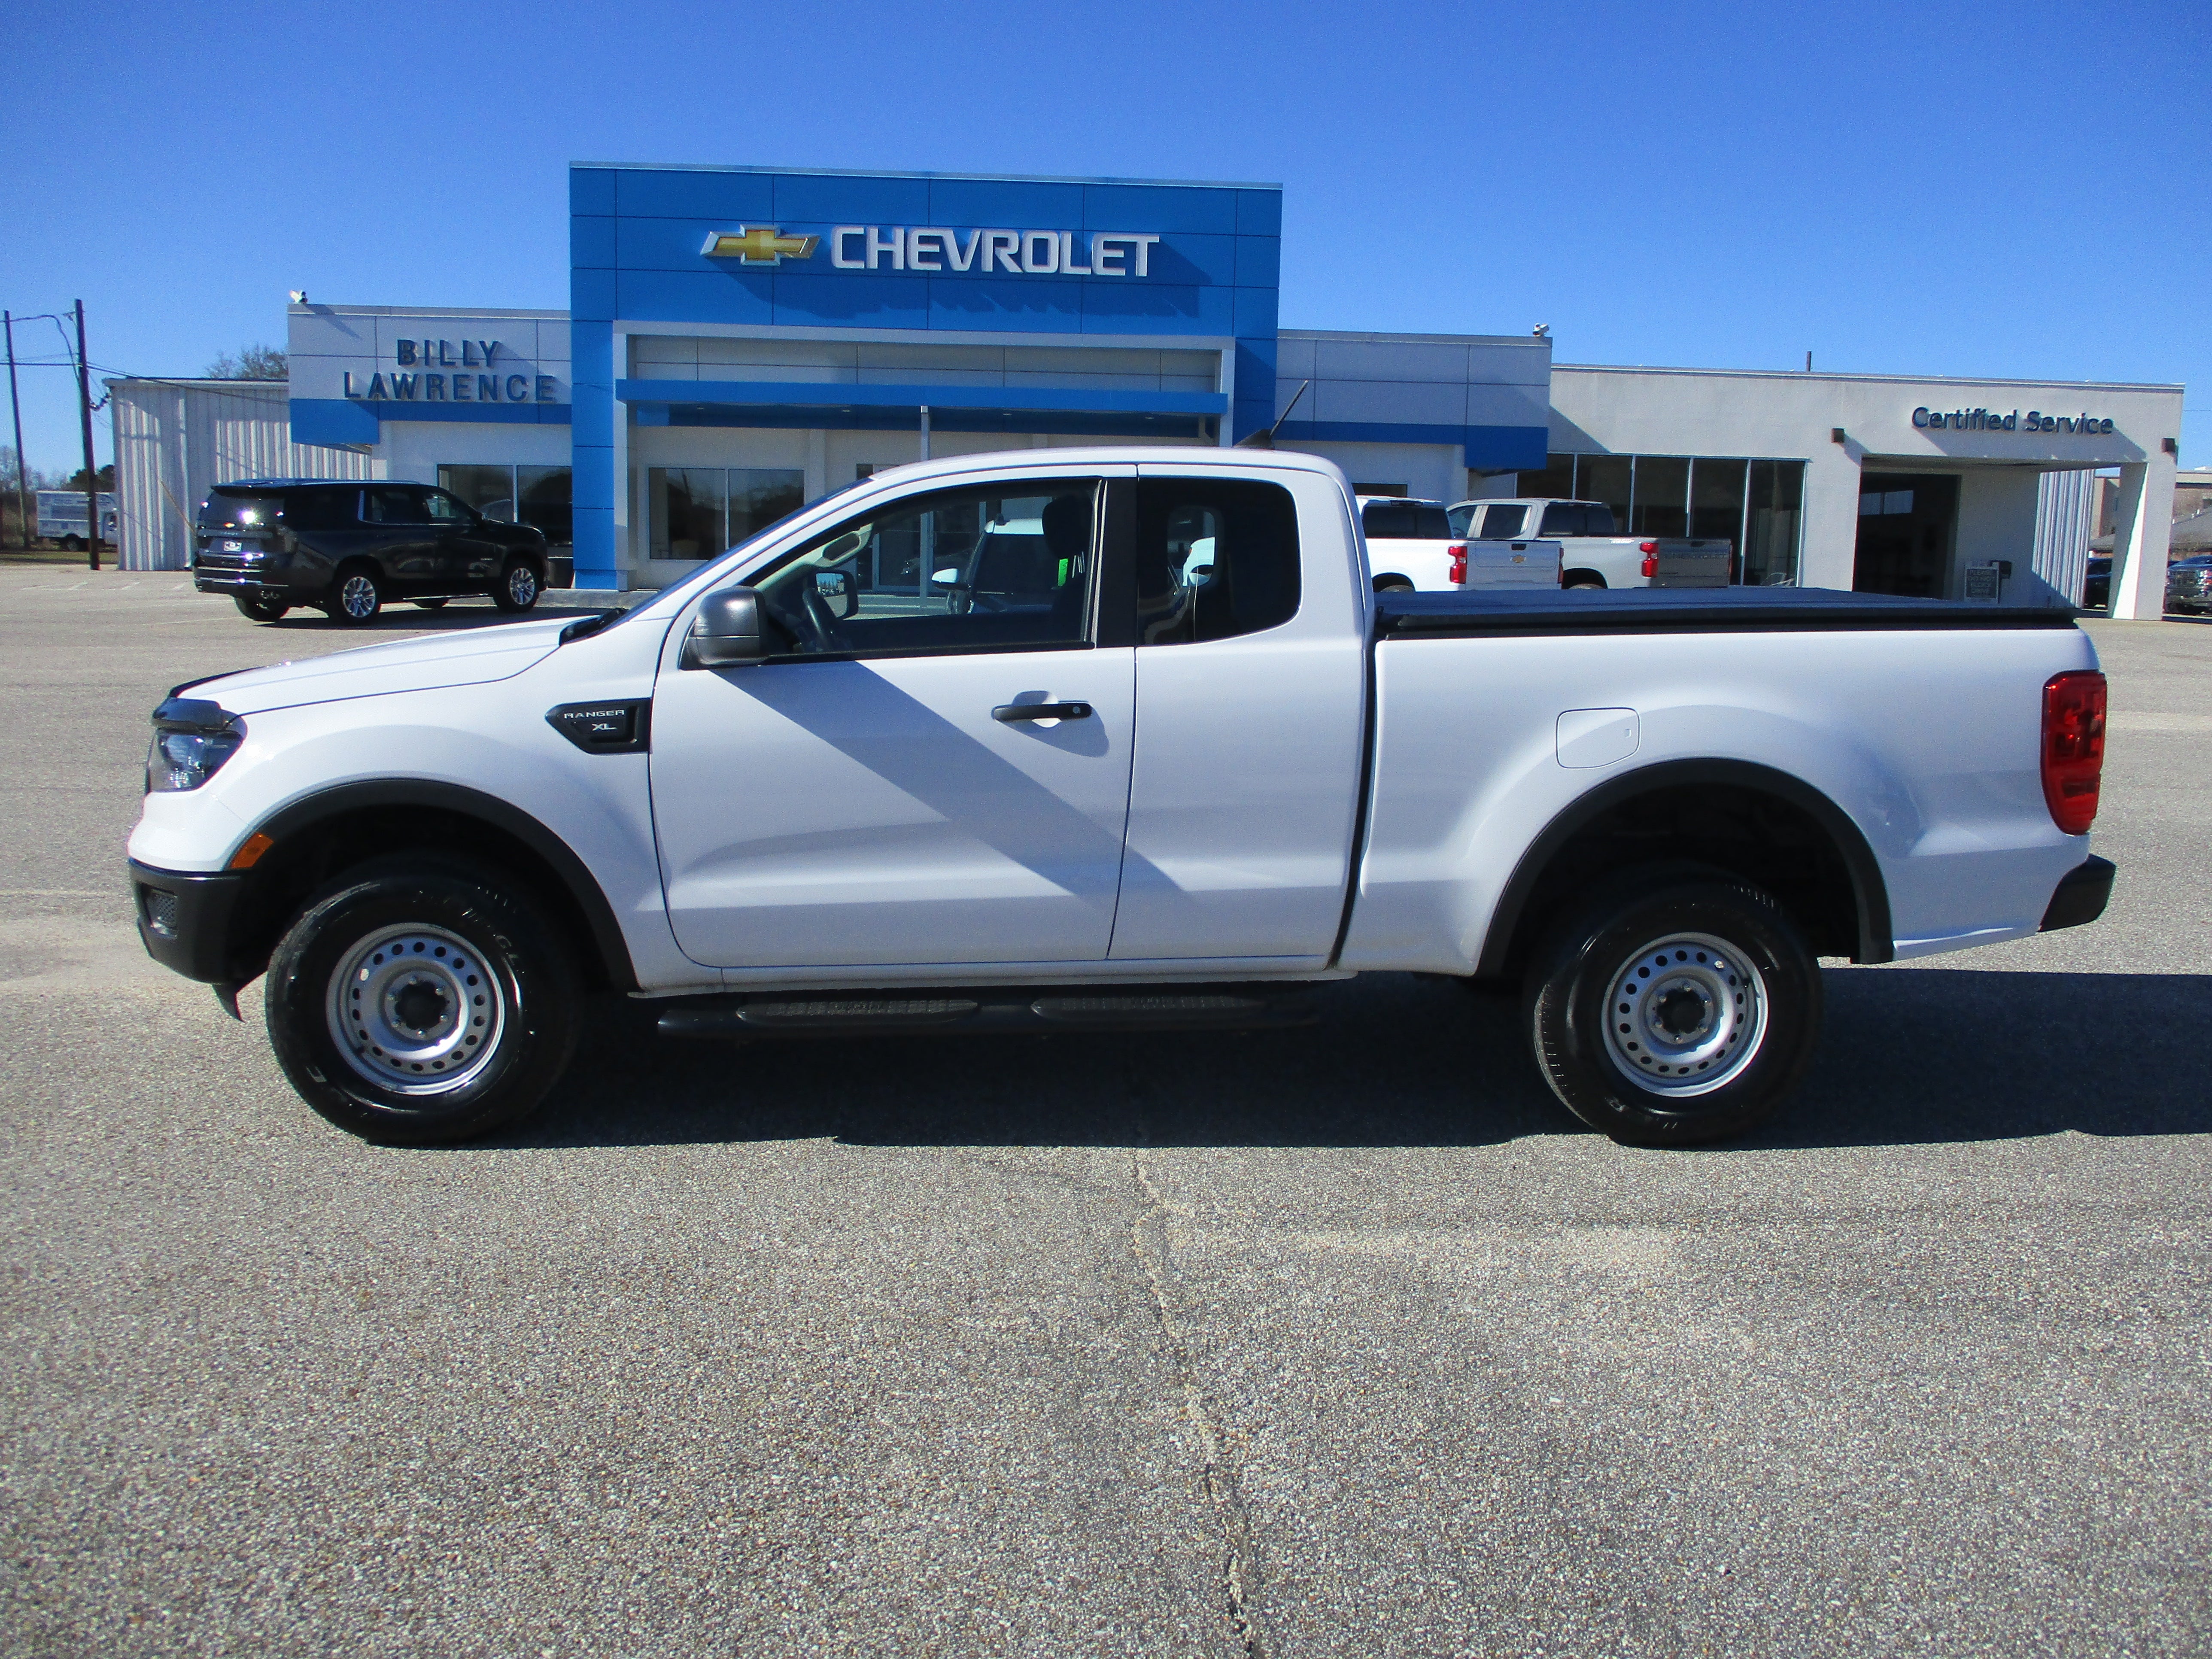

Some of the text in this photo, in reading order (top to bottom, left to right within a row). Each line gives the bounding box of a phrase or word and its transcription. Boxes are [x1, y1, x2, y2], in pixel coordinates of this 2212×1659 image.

[831, 226, 1160, 276] CHEVROLET
[397, 339, 500, 367] BILLY
[344, 371, 556, 402] LAWRENCE
[1911, 406, 2115, 434] Certified Service
[564, 709, 625, 719] RANGER
